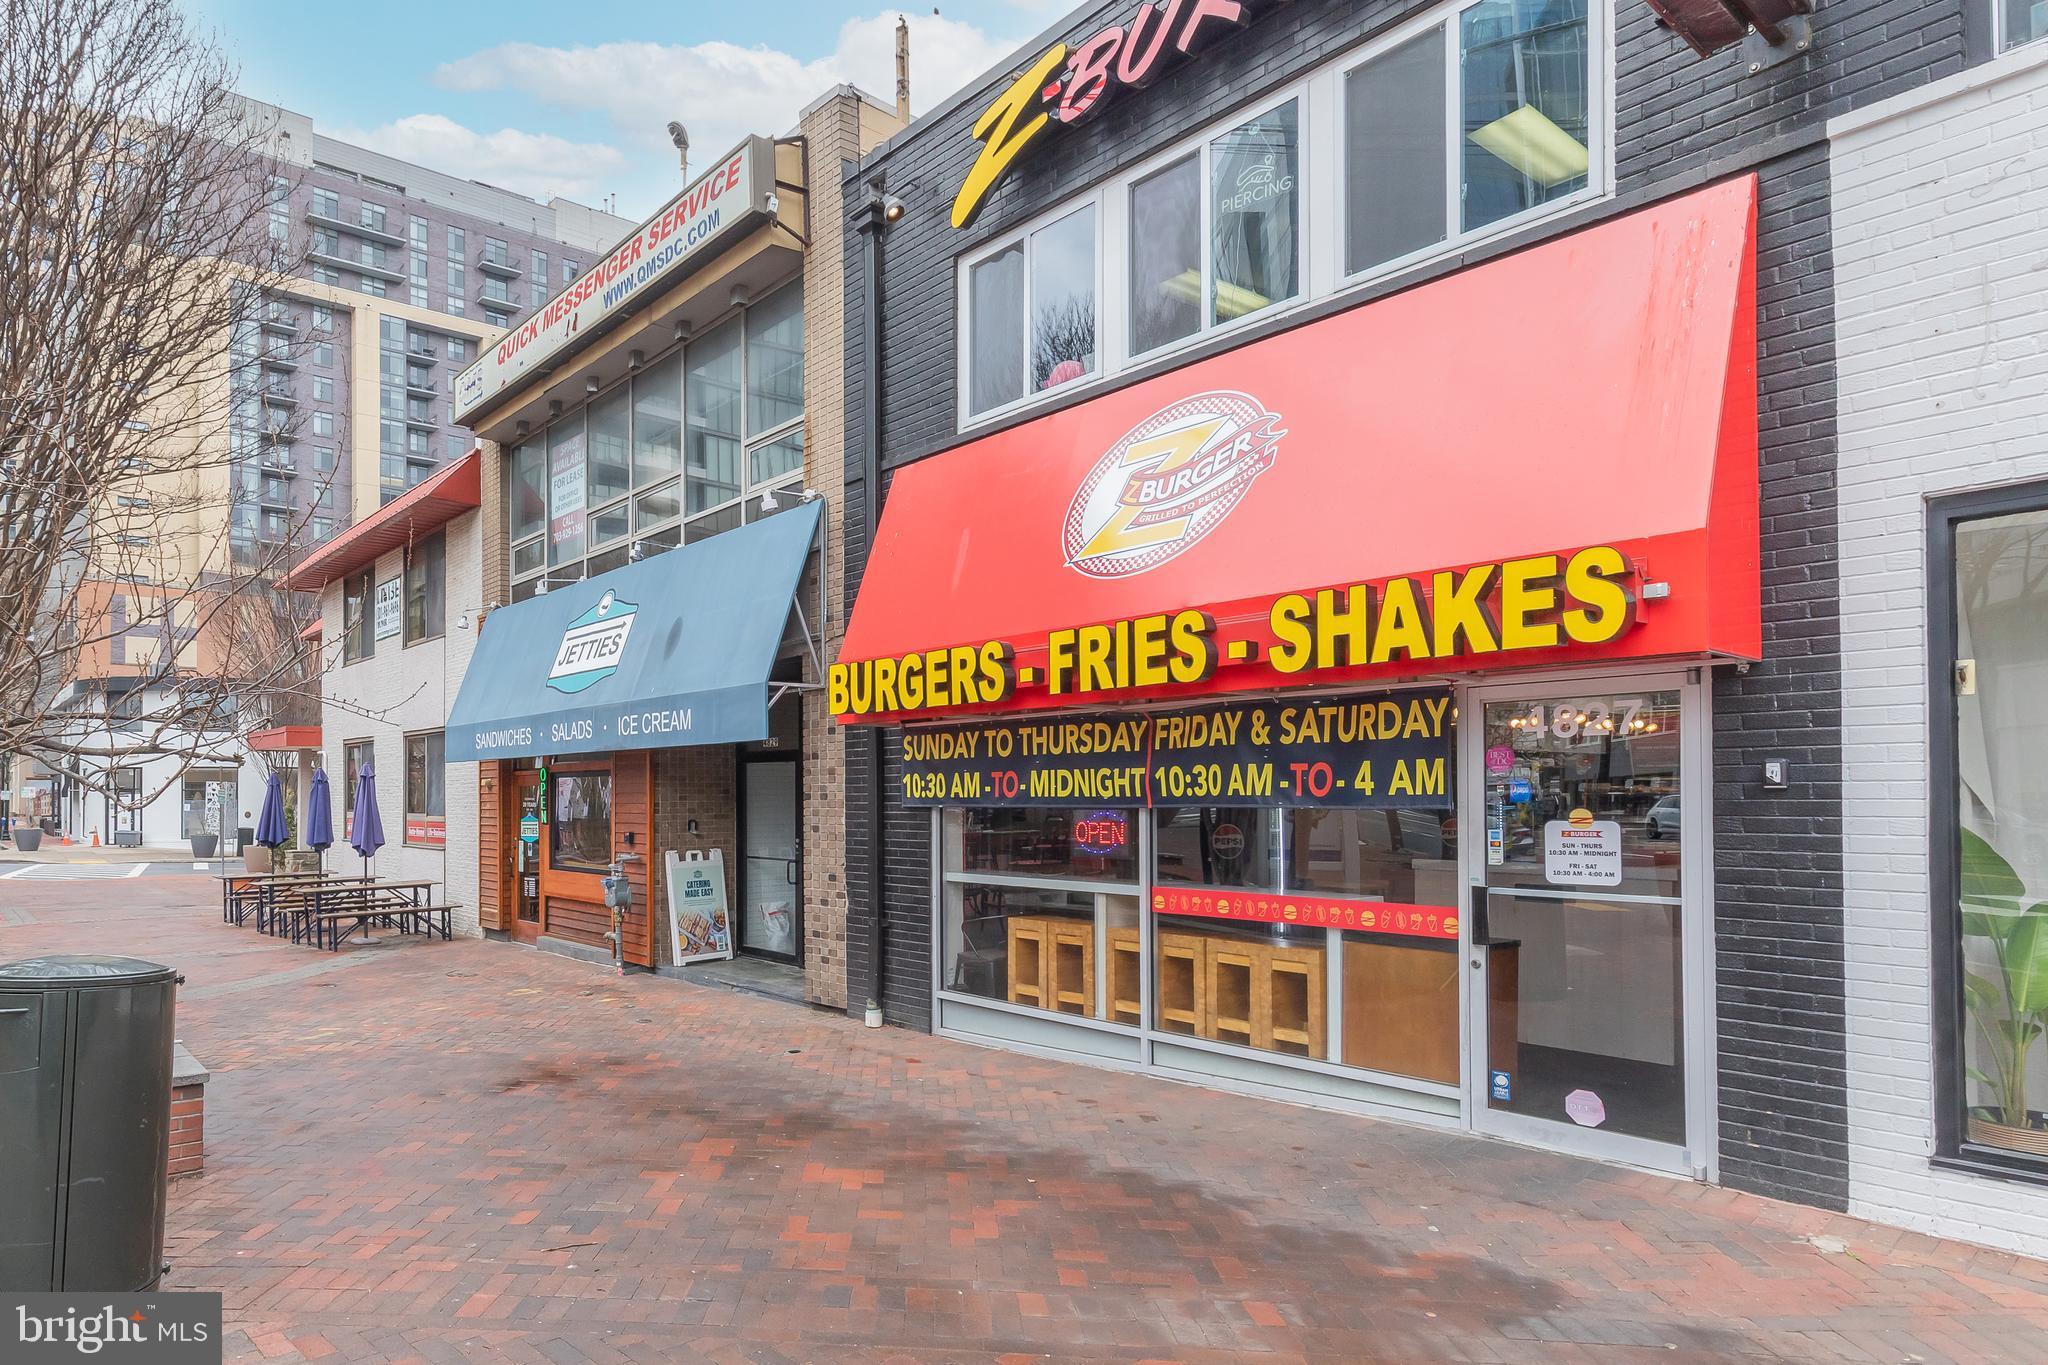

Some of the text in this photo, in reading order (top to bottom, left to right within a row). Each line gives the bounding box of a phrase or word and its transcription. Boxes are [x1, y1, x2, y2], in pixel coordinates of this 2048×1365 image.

[1221, 176, 1292, 213] PIERCING
[497, 155, 742, 365] QUICK MESSENGER SERVICE
[603, 208, 720, 309] WWW.QMSDC.COM
[553, 468, 584, 490] FOR LEASE
[1138, 461, 1265, 523] GRILLED TO PERFECTION
[562, 513, 574, 528] CALL
[558, 632, 622, 667] JETTIES
[828, 640, 1009, 716] BURGERS
[1049, 609, 1210, 695] FRIES
[1268, 546, 1630, 673] SHAKES
[475, 709, 692, 749] SANDWICHES SALADS ICE CREAM
[1155, 697, 1449, 750] FRIDAY & SATURDAY
[1522, 699, 1643, 739] 4827
[903, 720, 1147, 762] SUNDAY TO THURSDAY
[902, 772, 946, 799] 10:30
[950, 771, 980, 798] AM
[1030, 767, 1146, 798] MIDNIGHT
[1154, 764, 1222, 798] 10:30
[1227, 763, 1273, 797] AM
[1354, 760, 1375, 795] 4
[1388, 758, 1445, 795] AM
[1075, 821, 1126, 845] OPEN
[1214, 836, 1243, 846] PEPSI
[685, 887, 713, 898] MADE EASY
[687, 879, 711, 889] CATERING
